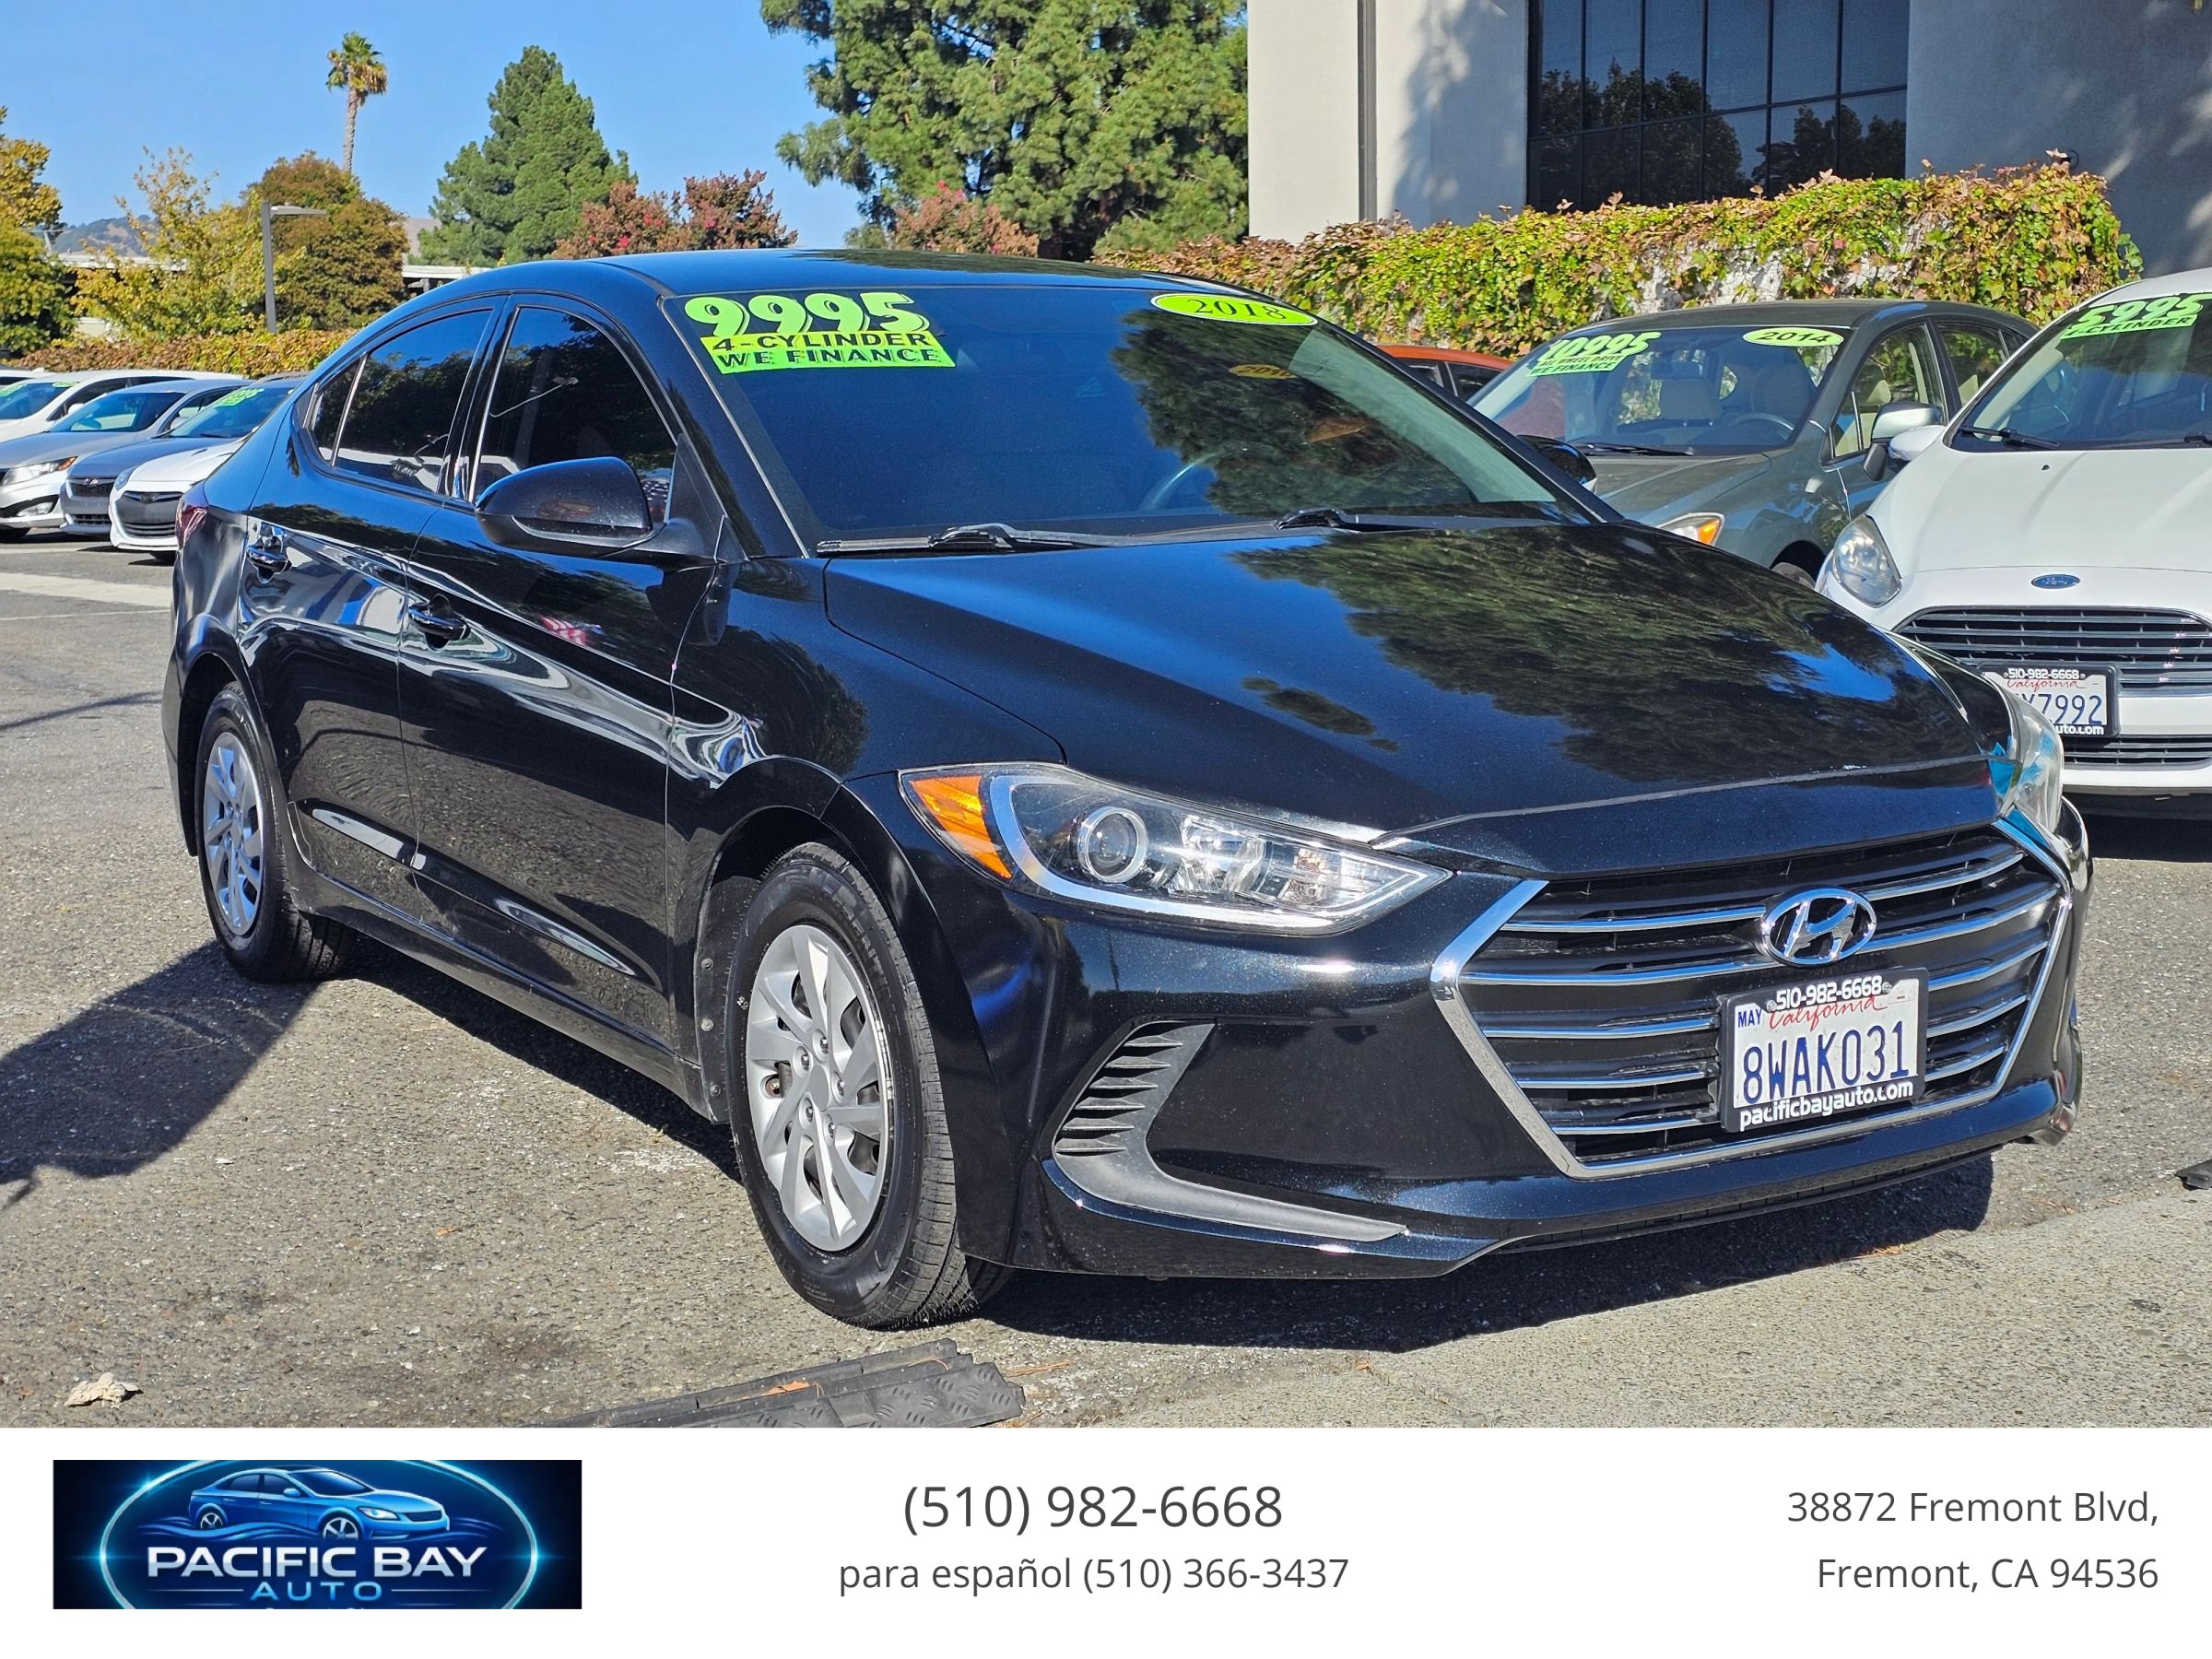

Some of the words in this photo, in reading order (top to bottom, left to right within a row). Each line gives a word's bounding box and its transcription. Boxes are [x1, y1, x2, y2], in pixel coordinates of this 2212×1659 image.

[684, 292, 930, 336] 9995
[1186, 299, 1288, 320] 2018
[2071, 293, 2212, 329] 5995
[712, 332, 932, 352] 4-CYLINDER
[1537, 331, 1662, 361] 10995
[1755, 331, 1832, 343] 2014
[717, 351, 775, 368] WE
[786, 347, 941, 364] FINANCE
[1551, 360, 1617, 373] FINANCE
[2006, 678, 2088, 693] California
[2007, 667, 2080, 680] 510-982-6668
[1775, 975, 1882, 1011] 510-982-6668
[1737, 1009, 1762, 1028] MAY
[1769, 994, 1888, 1031] California
[1743, 1020, 1909, 1104] 8WAK031
[1739, 1080, 1913, 1132] pacificbayauto.com
